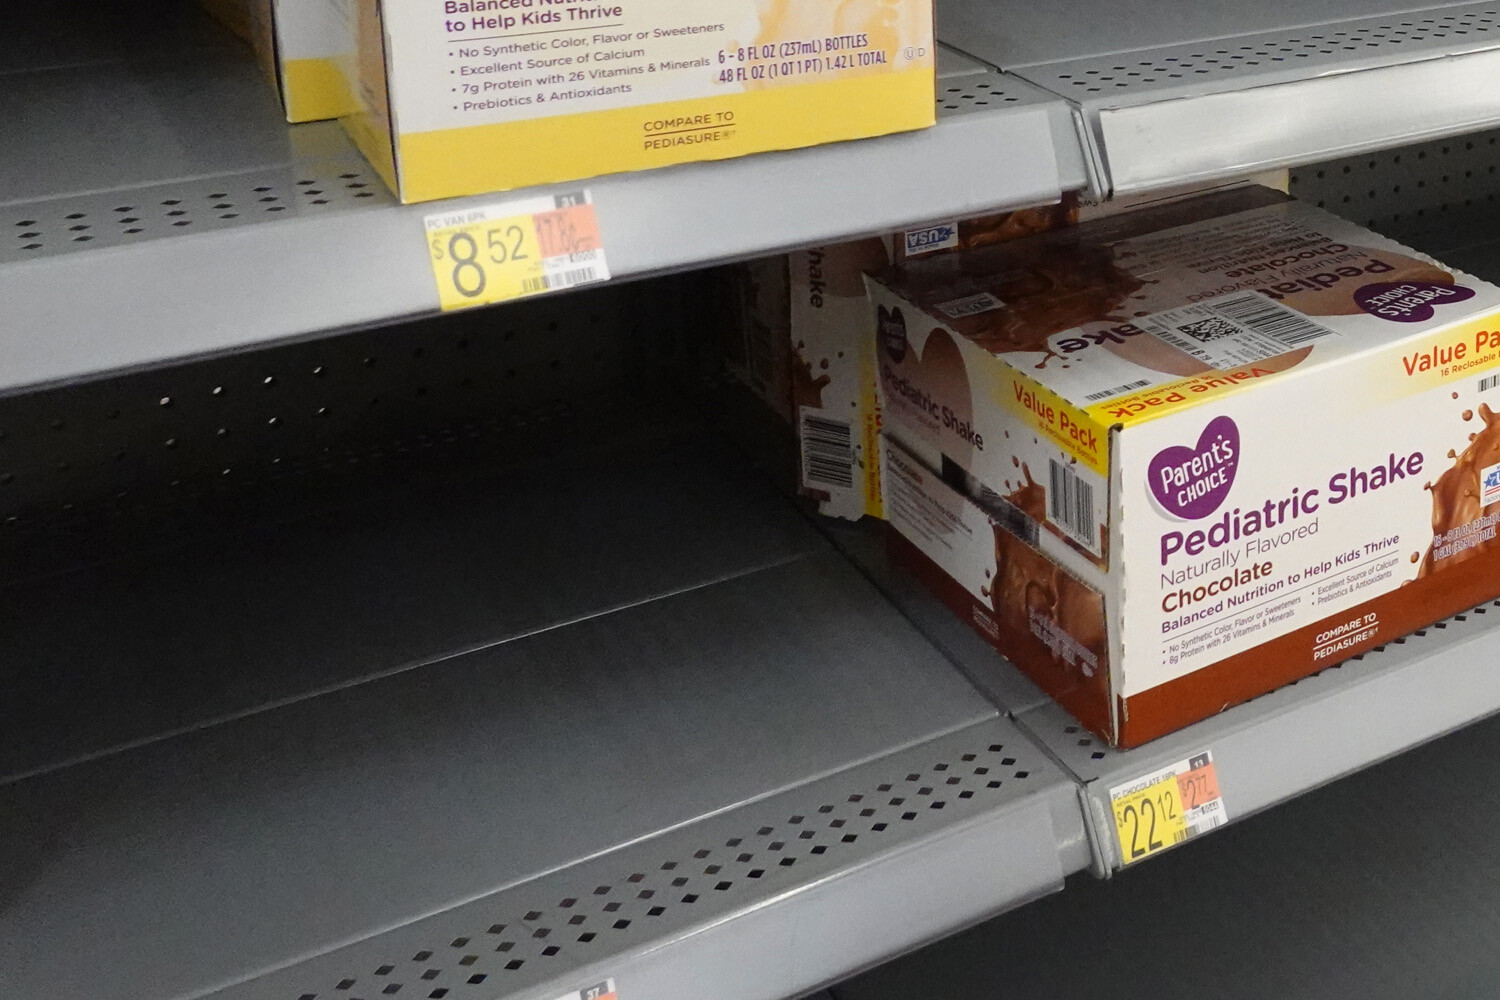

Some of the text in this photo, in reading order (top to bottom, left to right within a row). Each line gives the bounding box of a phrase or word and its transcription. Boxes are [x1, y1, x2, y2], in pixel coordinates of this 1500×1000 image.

[445, 3, 623, 33] to Help Kids Thrive
[459, 22, 725, 59] No Synthetic Color, Flavor or Sweeteners
[717, 33, 869, 64] 6 8 FL OZ (237mL) BOTTLES
[460, 47, 645, 77] Excellent Source of Calcium
[462, 57, 711, 96] 7g Protein with 26 Vitamins & Minerals
[719, 67, 734, 83] 48
[736, 66, 748, 81] FL
[751, 64, 765, 80] OZ
[781, 60, 795, 76] QT
[805, 56, 823, 74] PT)
[826, 54, 847, 71] 1.42
[858, 50, 888, 68] TOTAL
[463, 83, 633, 112] Prebiotics & Antioxidants
[643, 110, 735, 132] COMPARE TO
[1267, 258, 1397, 300] Pediat
[1402, 341, 1467, 376] Value
[1440, 368, 1450, 377] 16
[1452, 353, 1496, 375] Reclosable
[1108, 367, 1274, 418] Value Pack
[942, 408, 984, 451] Shake
[1013, 380, 1098, 453] Value Pack
[1161, 434, 1233, 493] Parent's
[1177, 467, 1228, 507] CHOICE
[1161, 451, 1424, 566] Pediatric Shake
[1161, 517, 1320, 590] Naturally Flavored
[1161, 534, 1400, 634] Balanced Nutrition to Help Kids Thrive
[1161, 561, 1273, 614] Chocolate
[1317, 579, 1345, 596] Excellent
[1346, 570, 1368, 585] Source
[1375, 557, 1399, 572] Calcium
[1317, 588, 1348, 606] Prebiotics
[1355, 570, 1393, 591] Antioxidants
[1169, 644, 1179, 654] No
[1180, 632, 1213, 651] Synthetic
[1214, 623, 1234, 638] Color,
[1234, 615, 1255, 632] Flavor
[1265, 595, 1302, 616] Sweeteners
[1180, 644, 1205, 661] Protein
[1206, 638, 1222, 651] with
[1222, 634, 1232, 645] 26
[1232, 623, 1262, 642] Vitamins
[1268, 609, 1296, 627] Minerals
[1315, 611, 1377, 645] COMPARE TO
